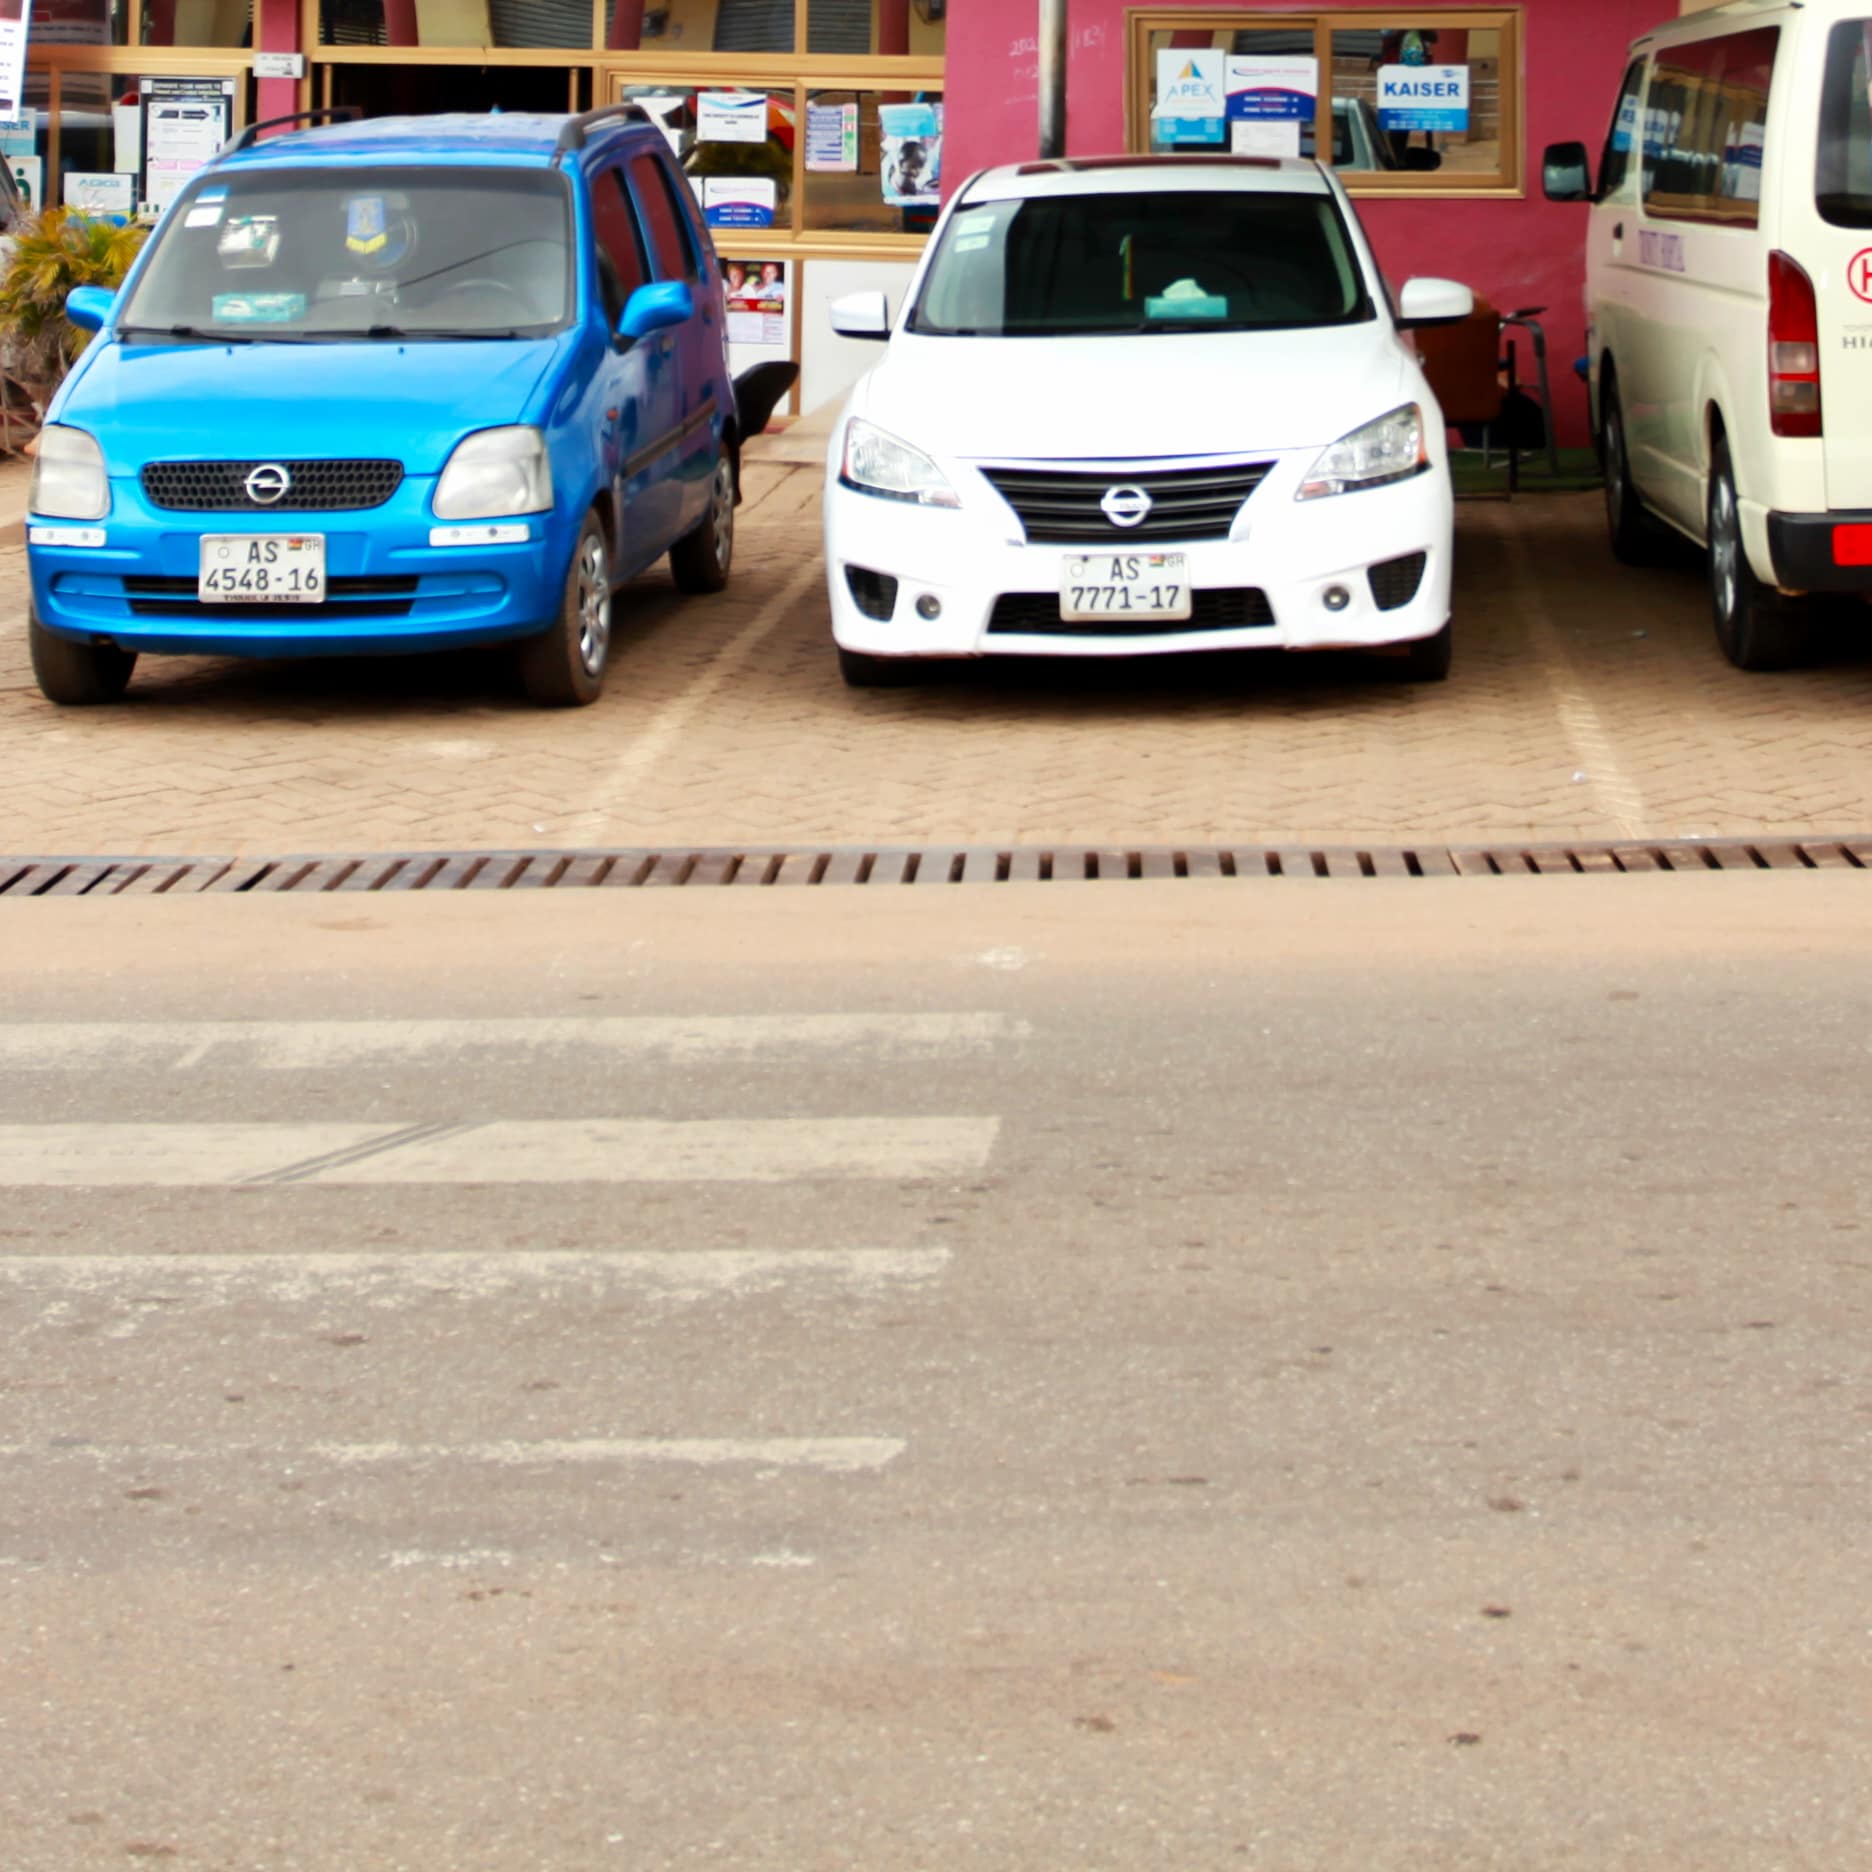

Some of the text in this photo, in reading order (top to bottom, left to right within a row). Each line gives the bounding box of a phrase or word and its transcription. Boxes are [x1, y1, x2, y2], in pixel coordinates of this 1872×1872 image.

[1164, 83, 1217, 105] APEX
[1384, 82, 1460, 97] KAISER
[248, 540, 279, 564] AS
[205, 568, 319, 591] 4548-16
[1110, 556, 1140, 581] AS
[1071, 585, 1179, 610] 7771-17
